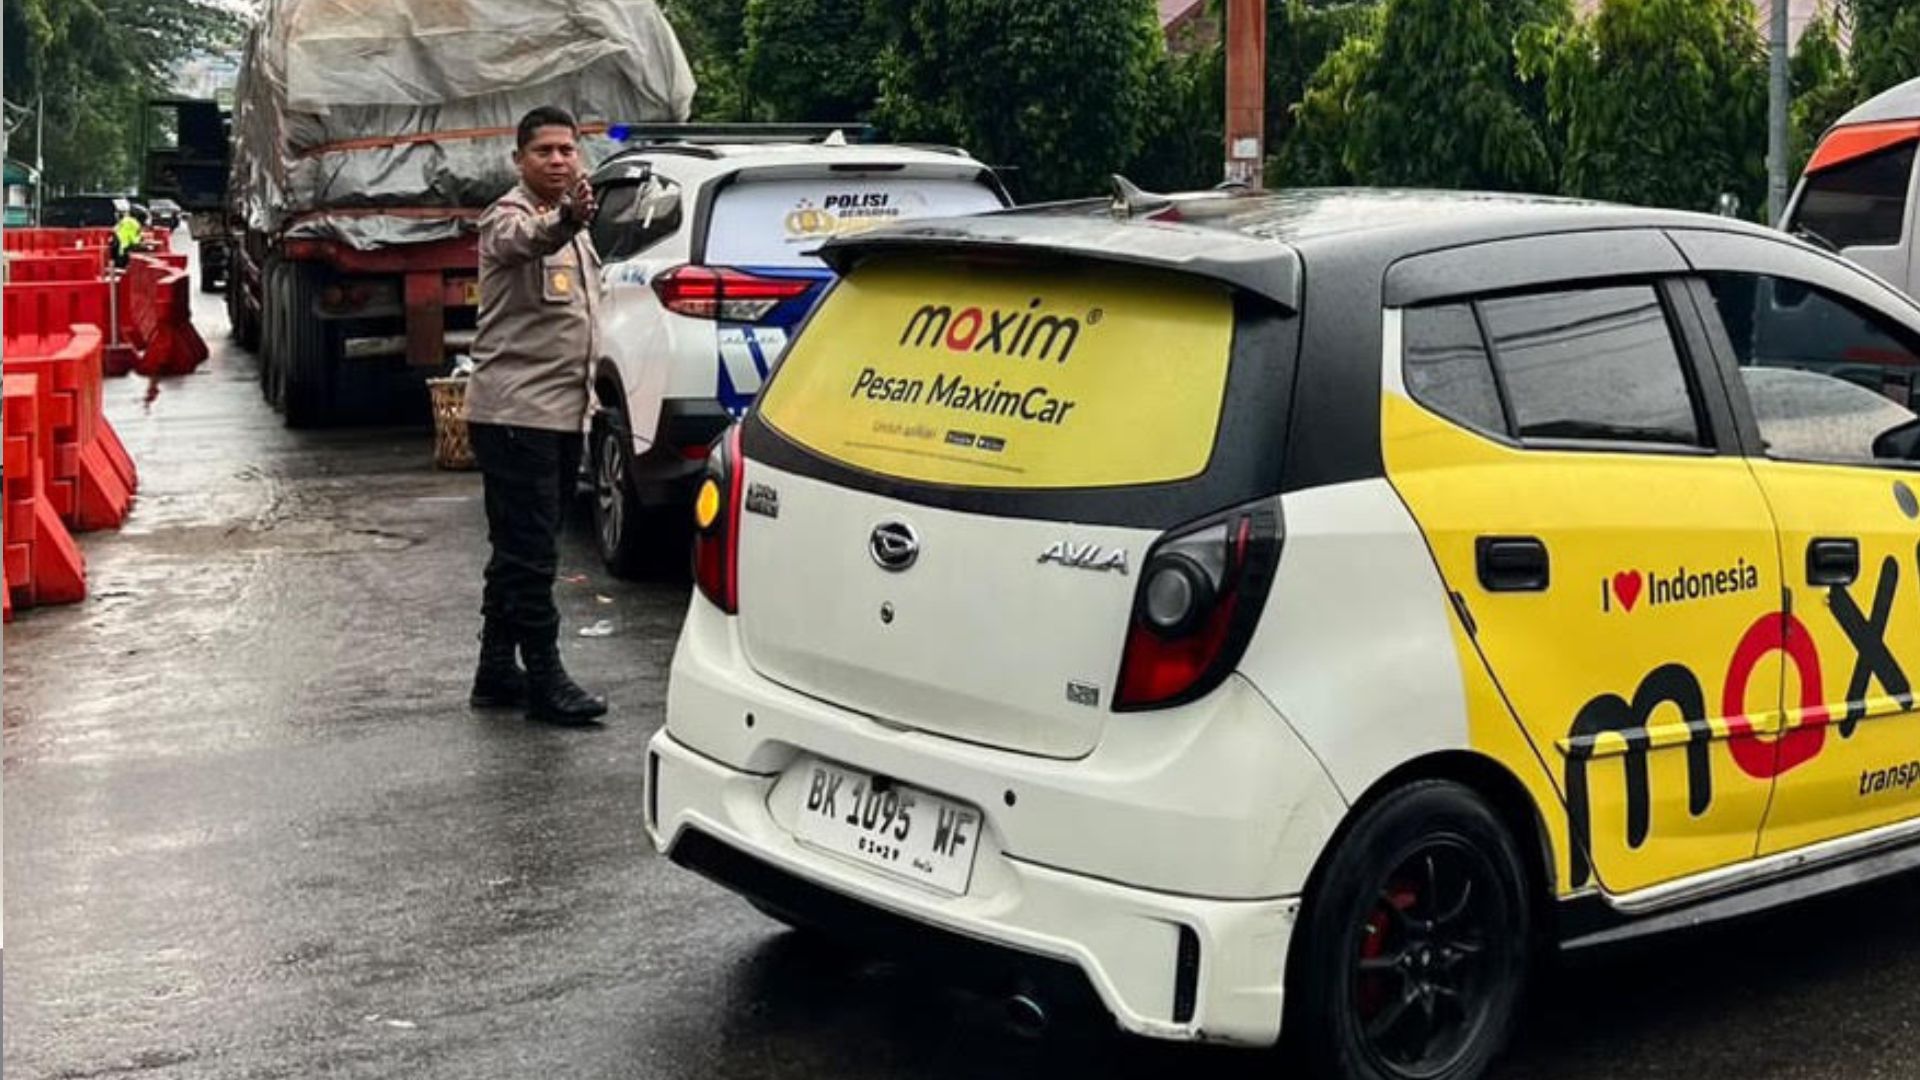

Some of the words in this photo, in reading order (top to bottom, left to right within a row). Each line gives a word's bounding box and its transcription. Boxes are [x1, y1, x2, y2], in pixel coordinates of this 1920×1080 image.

[824, 193, 889, 209] POLISI
[900, 298, 1081, 364] maxim
[851, 367, 923, 405] Pesan
[927, 373, 1075, 426] MaximCar
[1648, 557, 1758, 605] Indonesia
[807, 769, 844, 818] BK
[847, 781, 916, 842] 1095
[932, 805, 975, 858] WF
